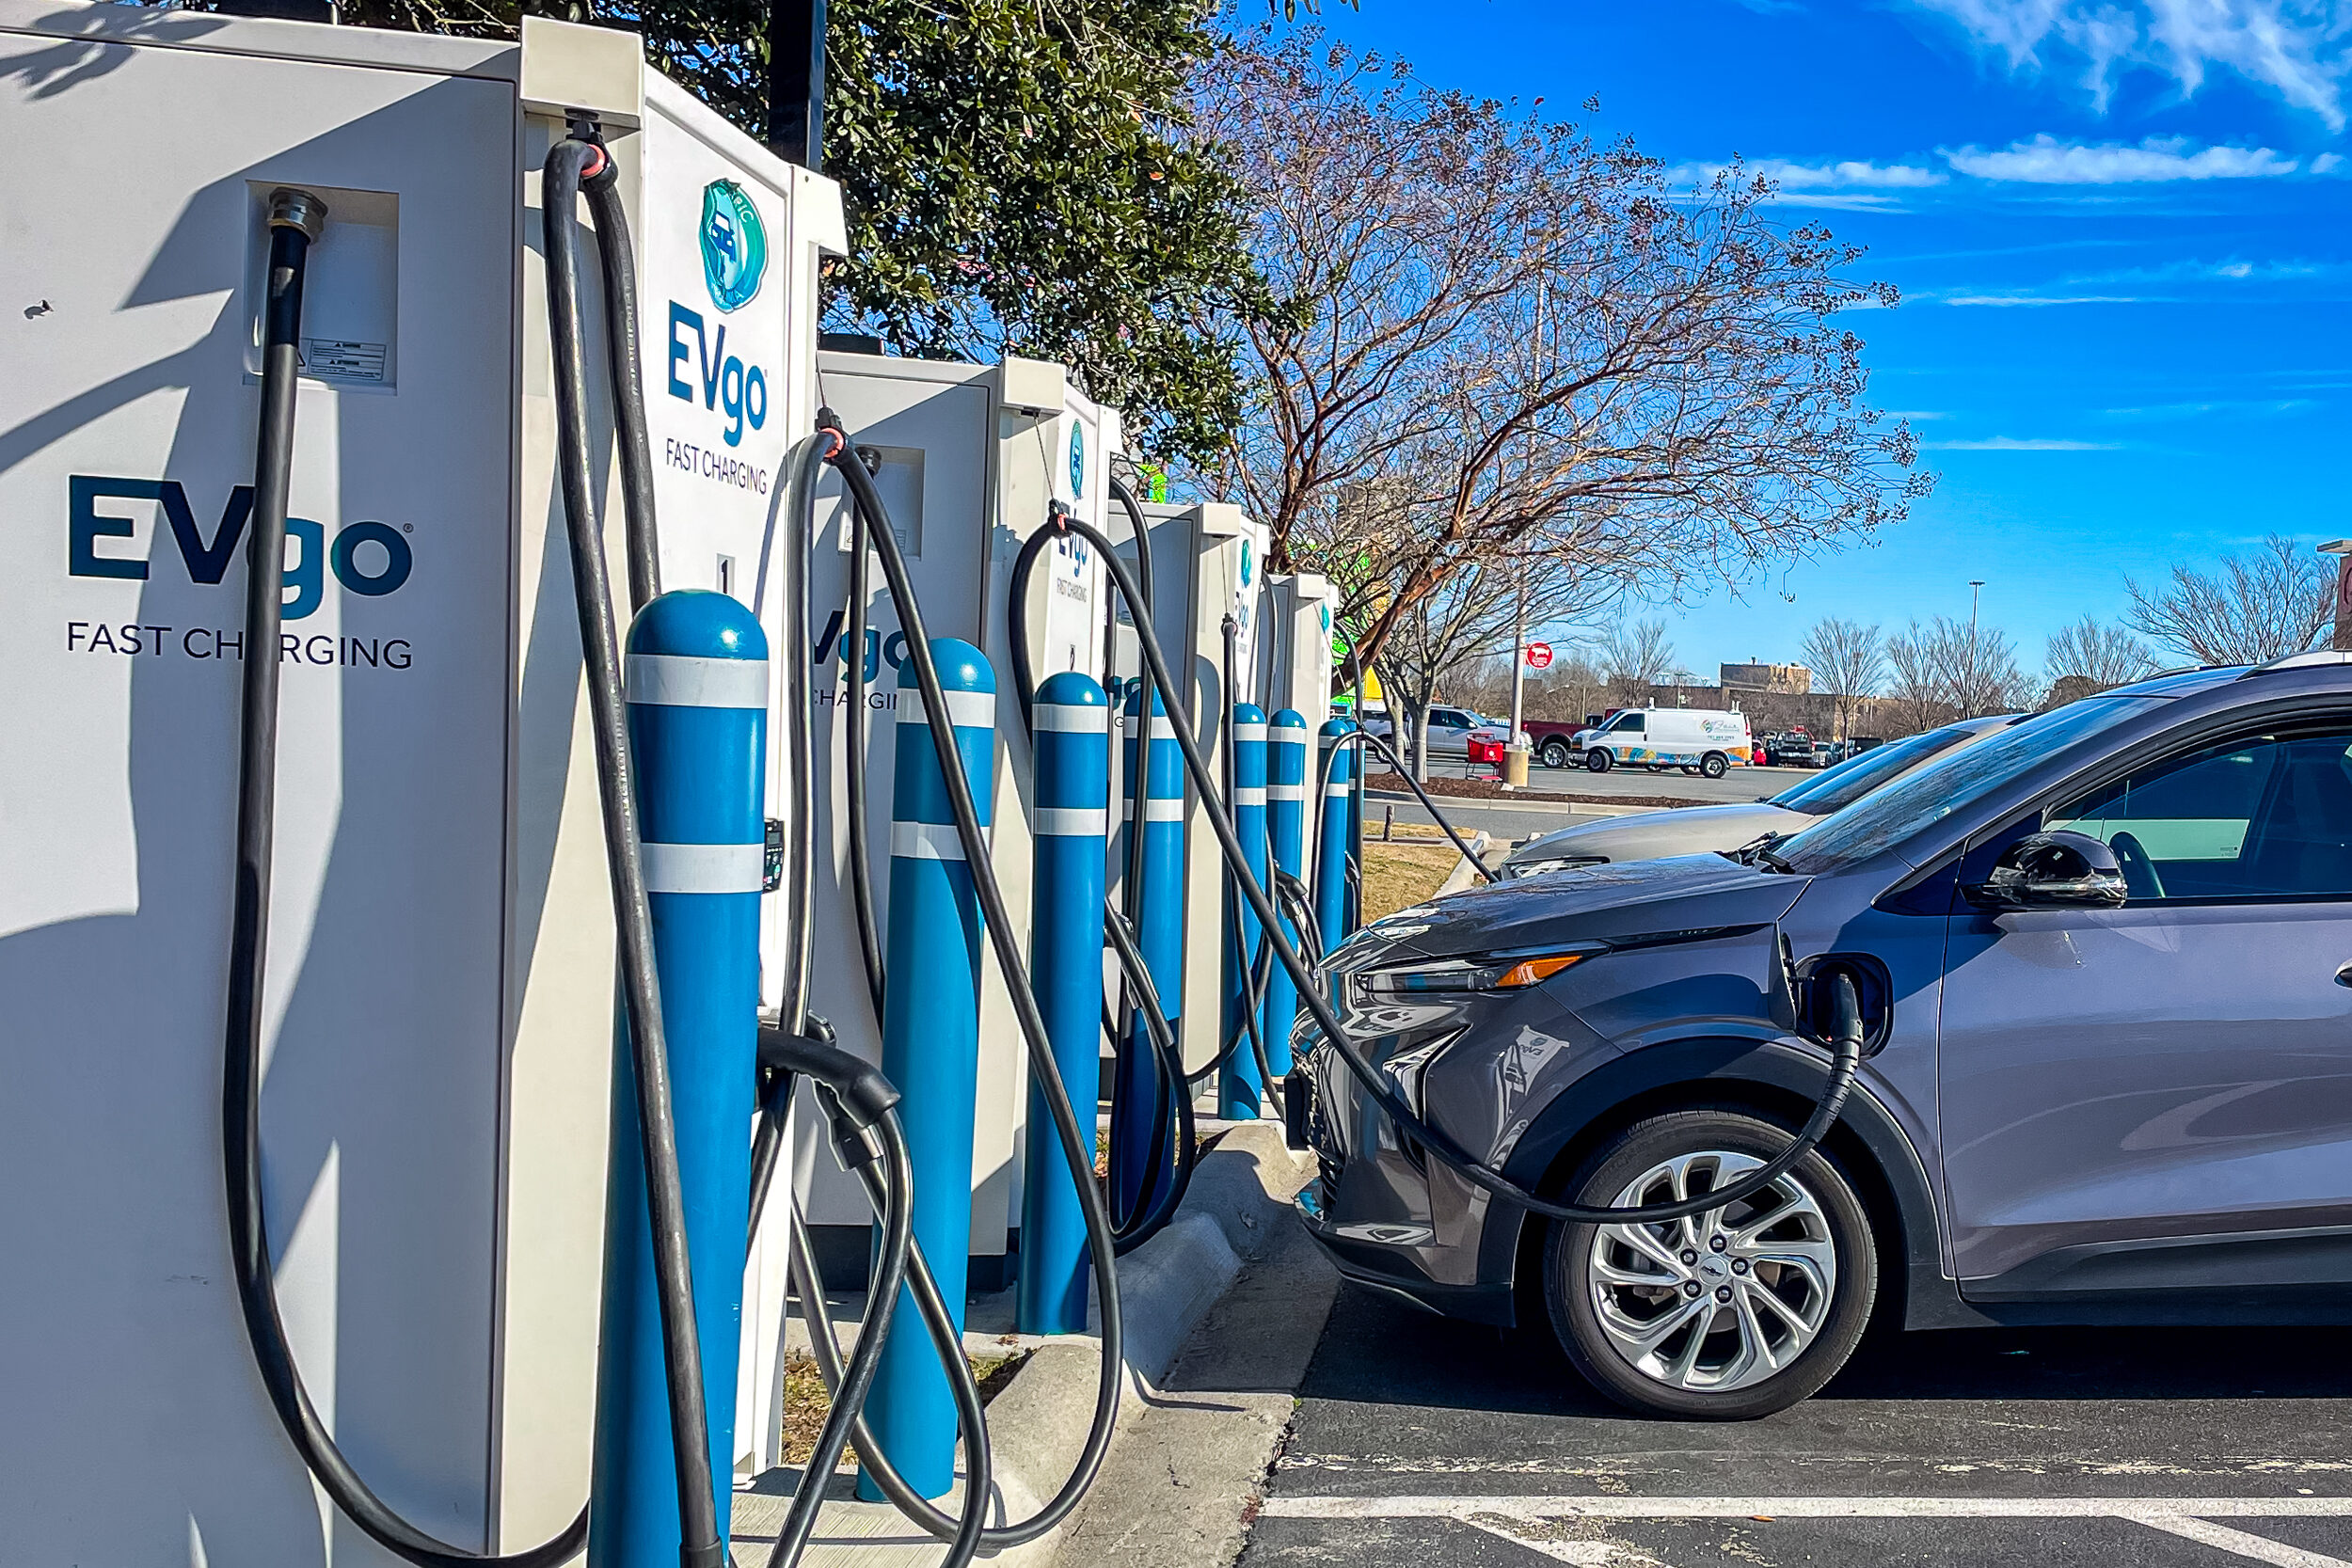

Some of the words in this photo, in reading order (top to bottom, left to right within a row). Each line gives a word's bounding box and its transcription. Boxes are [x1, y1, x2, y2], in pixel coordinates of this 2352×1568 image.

[669, 299, 767, 447] EVgo
[666, 437, 700, 473] FAST
[702, 451, 766, 494] CHARGING
[721, 559, 728, 594] 1
[68, 622, 172, 656] FAST
[183, 628, 412, 670] CHRGING
